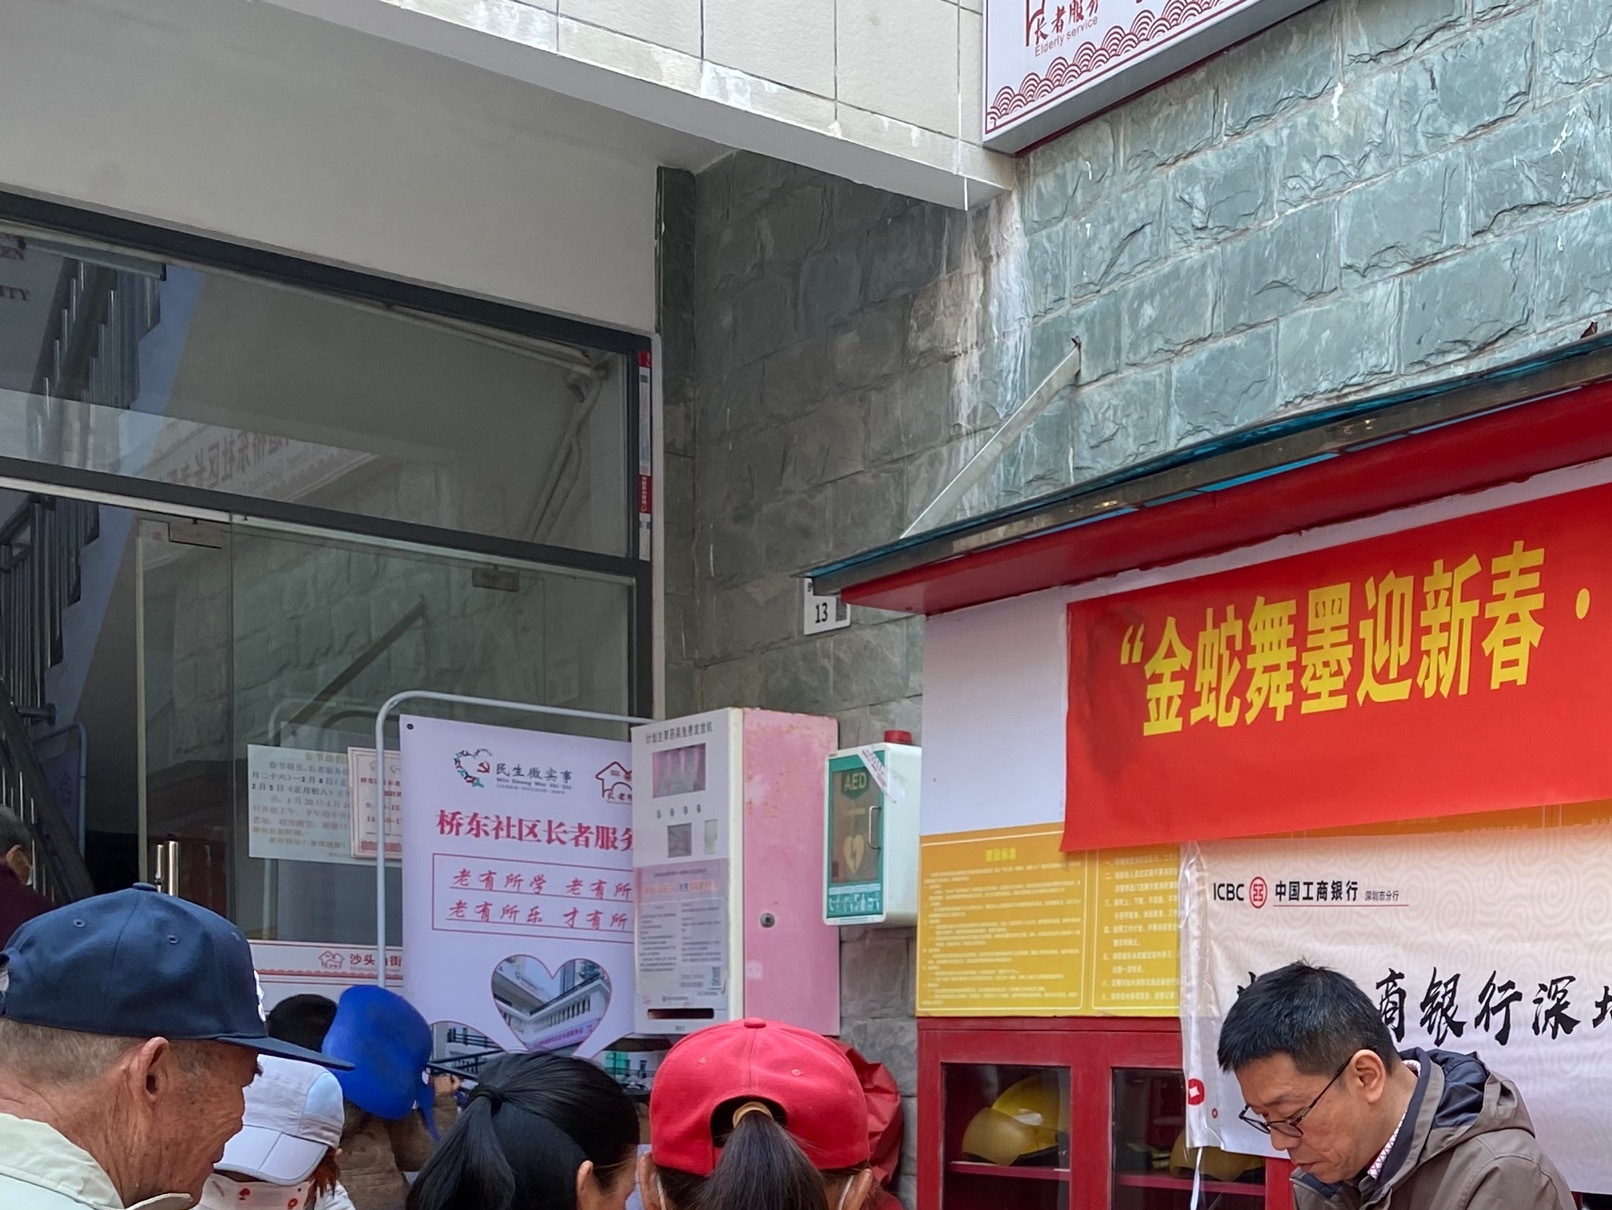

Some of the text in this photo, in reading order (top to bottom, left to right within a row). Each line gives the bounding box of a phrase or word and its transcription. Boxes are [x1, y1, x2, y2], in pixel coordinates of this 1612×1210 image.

[1034, 16, 1099, 58] Elderly service
[815, 602, 828, 623] 13
[844, 772, 867, 791] AED
[453, 868, 547, 894] 老有所学
[1275, 880, 1399, 902] 中国工商银行 深圳市分行
[1213, 883, 1245, 901] ICBC
[449, 900, 543, 923] 老有所乐
[350, 953, 402, 967] 沙头街
